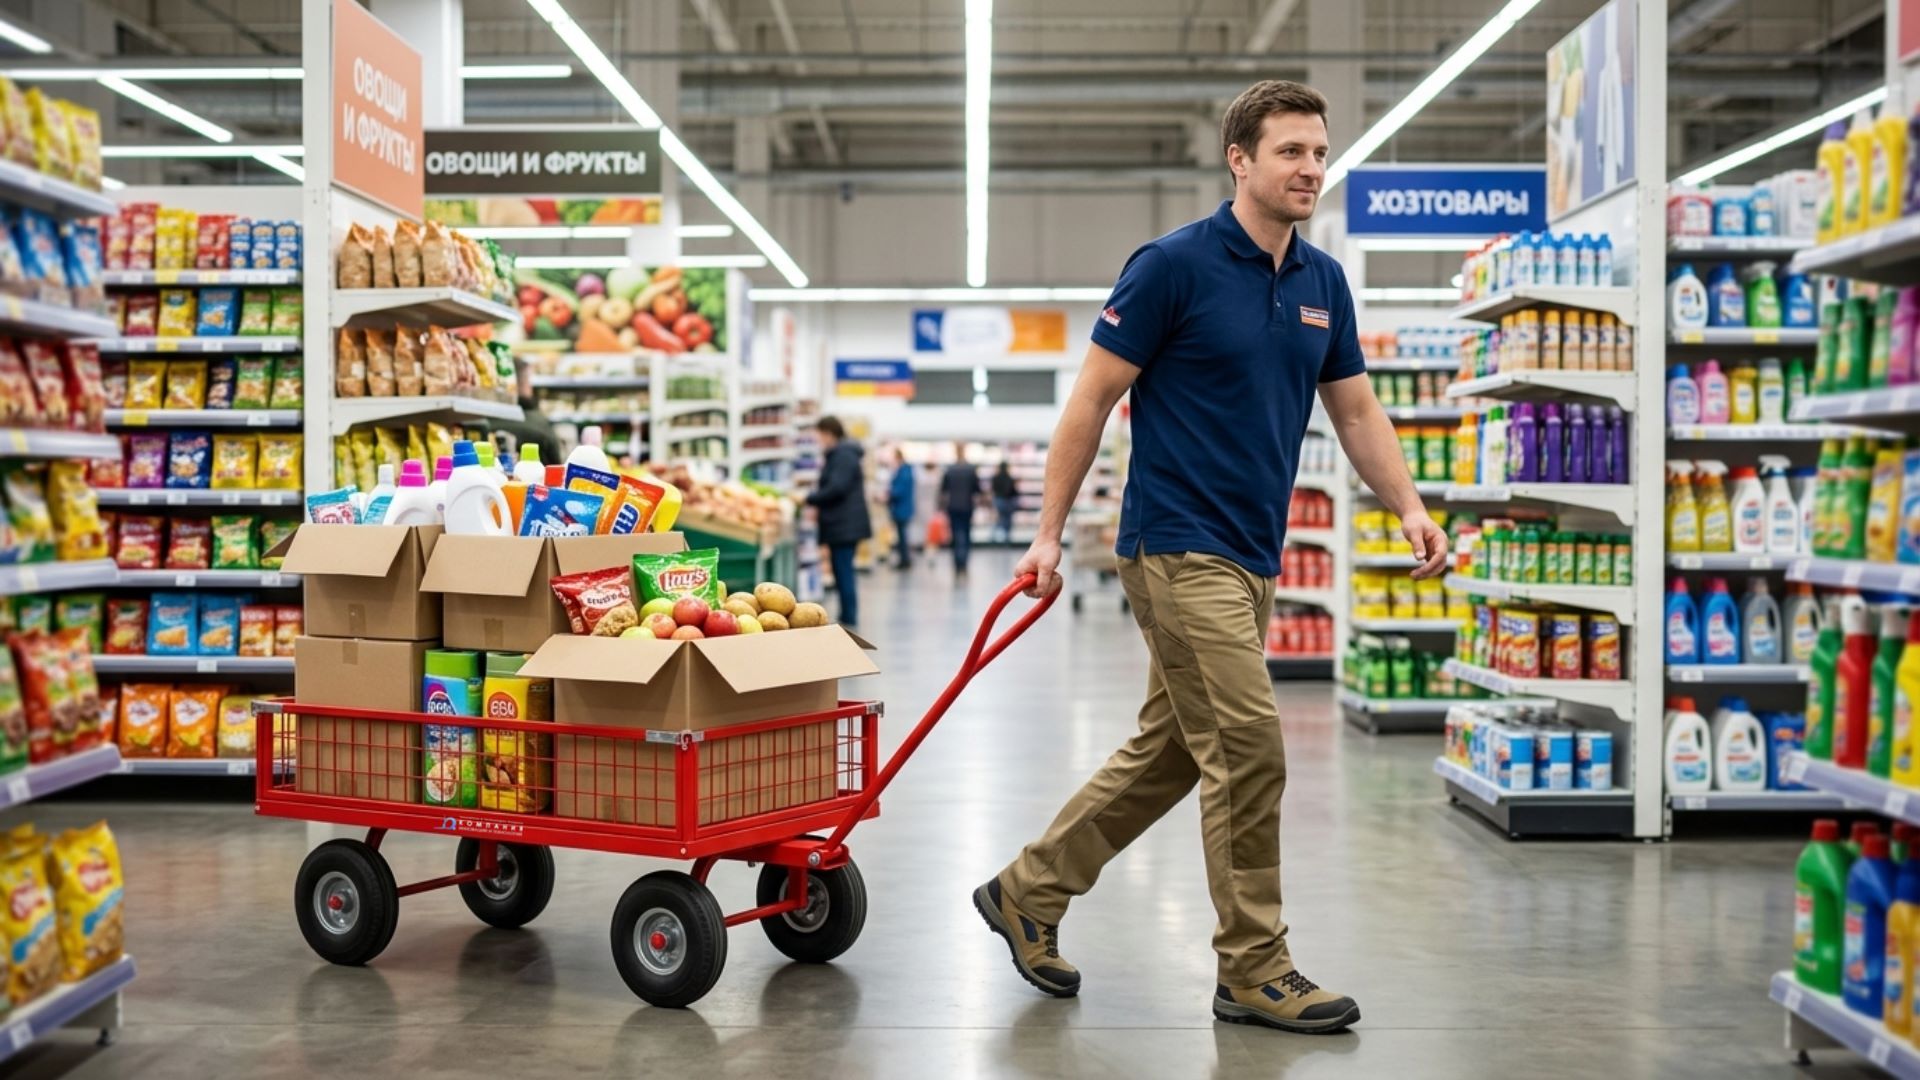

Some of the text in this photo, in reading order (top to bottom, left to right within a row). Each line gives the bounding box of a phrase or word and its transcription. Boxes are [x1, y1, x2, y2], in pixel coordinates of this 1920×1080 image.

[354, 57, 407, 122] ОВОЩИ
[343, 103, 415, 175] И ФРУКТЫ
[426, 150, 647, 177] ОВОЩИ И ФРУКТЫ
[1367, 190, 1529, 215] ХОЗТОВАРЫ
